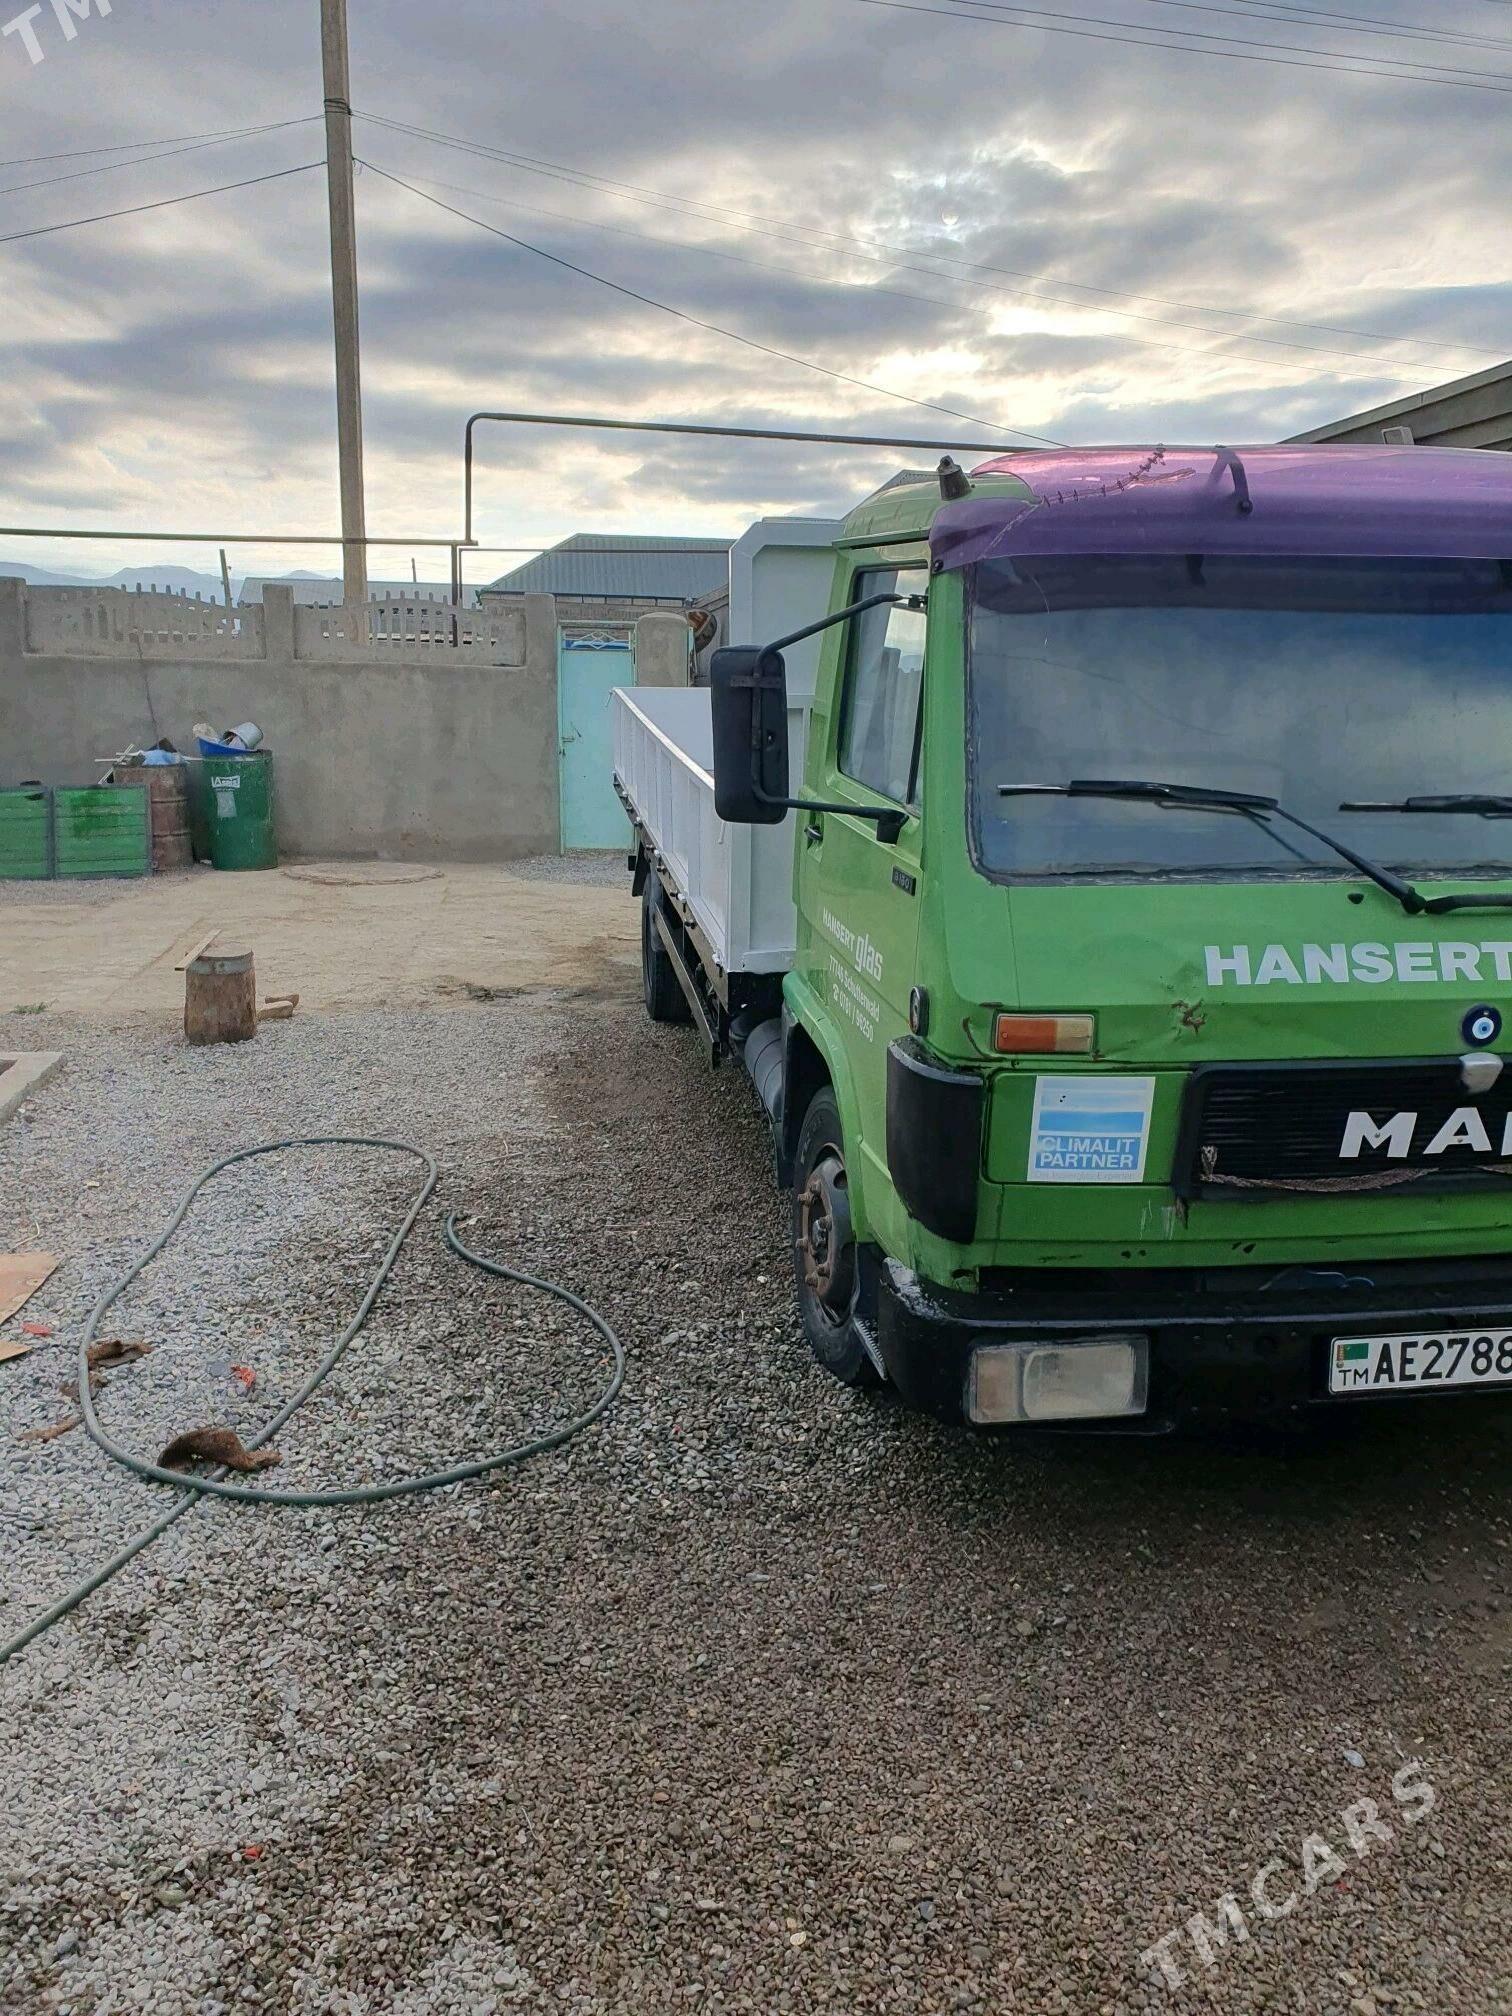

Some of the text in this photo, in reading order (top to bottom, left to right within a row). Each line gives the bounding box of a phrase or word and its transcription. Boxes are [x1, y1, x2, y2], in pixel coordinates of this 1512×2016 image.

[822, 906, 884, 982] HANSERT glas
[1204, 942, 1512, 986] HANSERT
[1041, 1137, 1135, 1153] CLIMALIT
[1339, 1107, 1512, 1158] MA
[1039, 1152, 1134, 1168] PARTNER
[1338, 1336, 1512, 1386] TM AE2788
